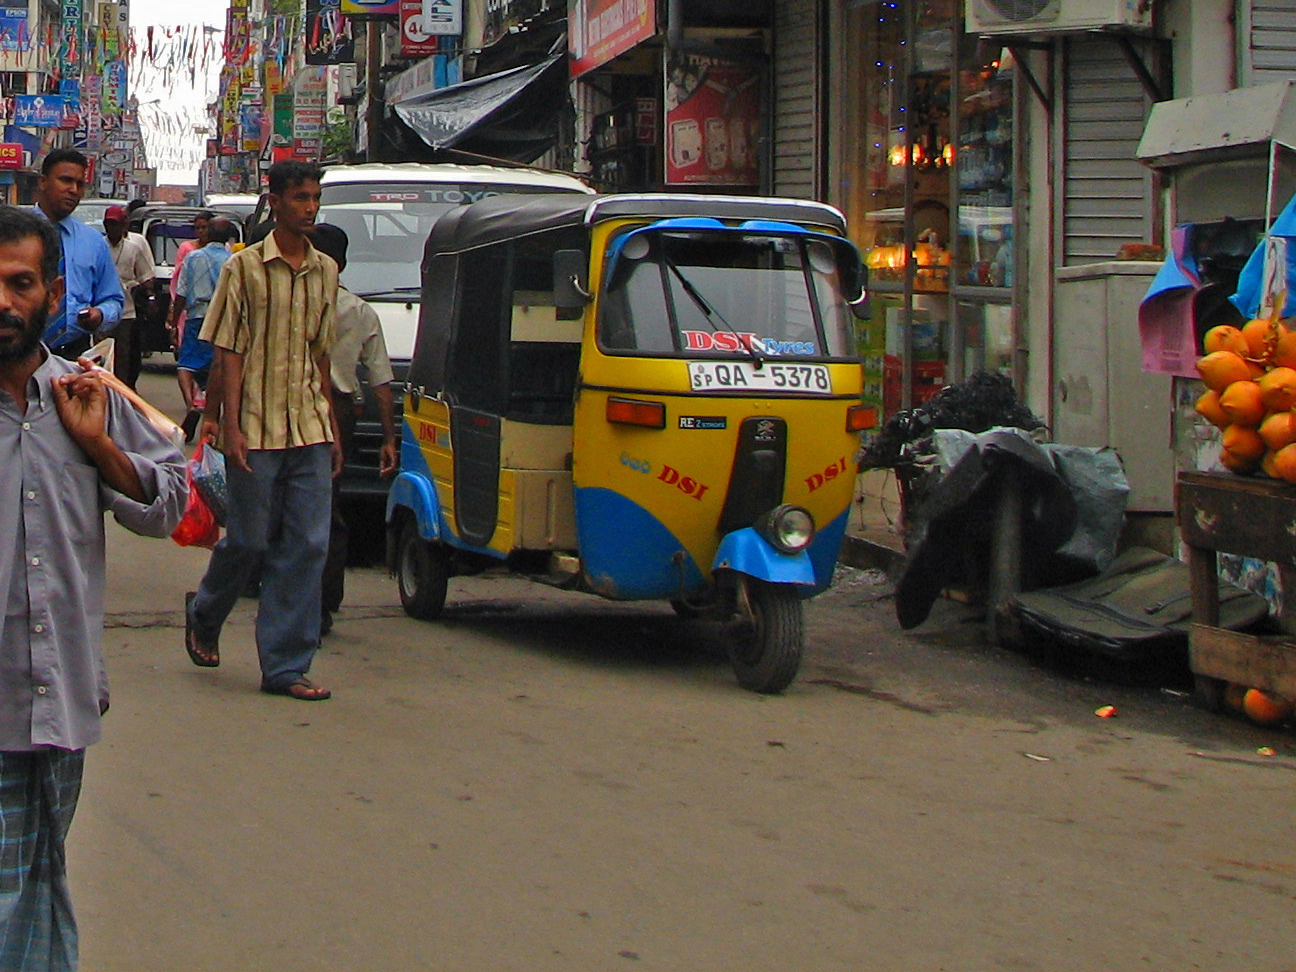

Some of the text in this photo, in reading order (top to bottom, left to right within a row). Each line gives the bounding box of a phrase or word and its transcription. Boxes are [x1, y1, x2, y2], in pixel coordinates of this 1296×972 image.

[370, 192, 419, 201] TRD
[762, 337, 816, 355] Tyres
[680, 417, 695, 428] RE
[658, 464, 710, 501] DSI
[804, 457, 848, 493] DSI
